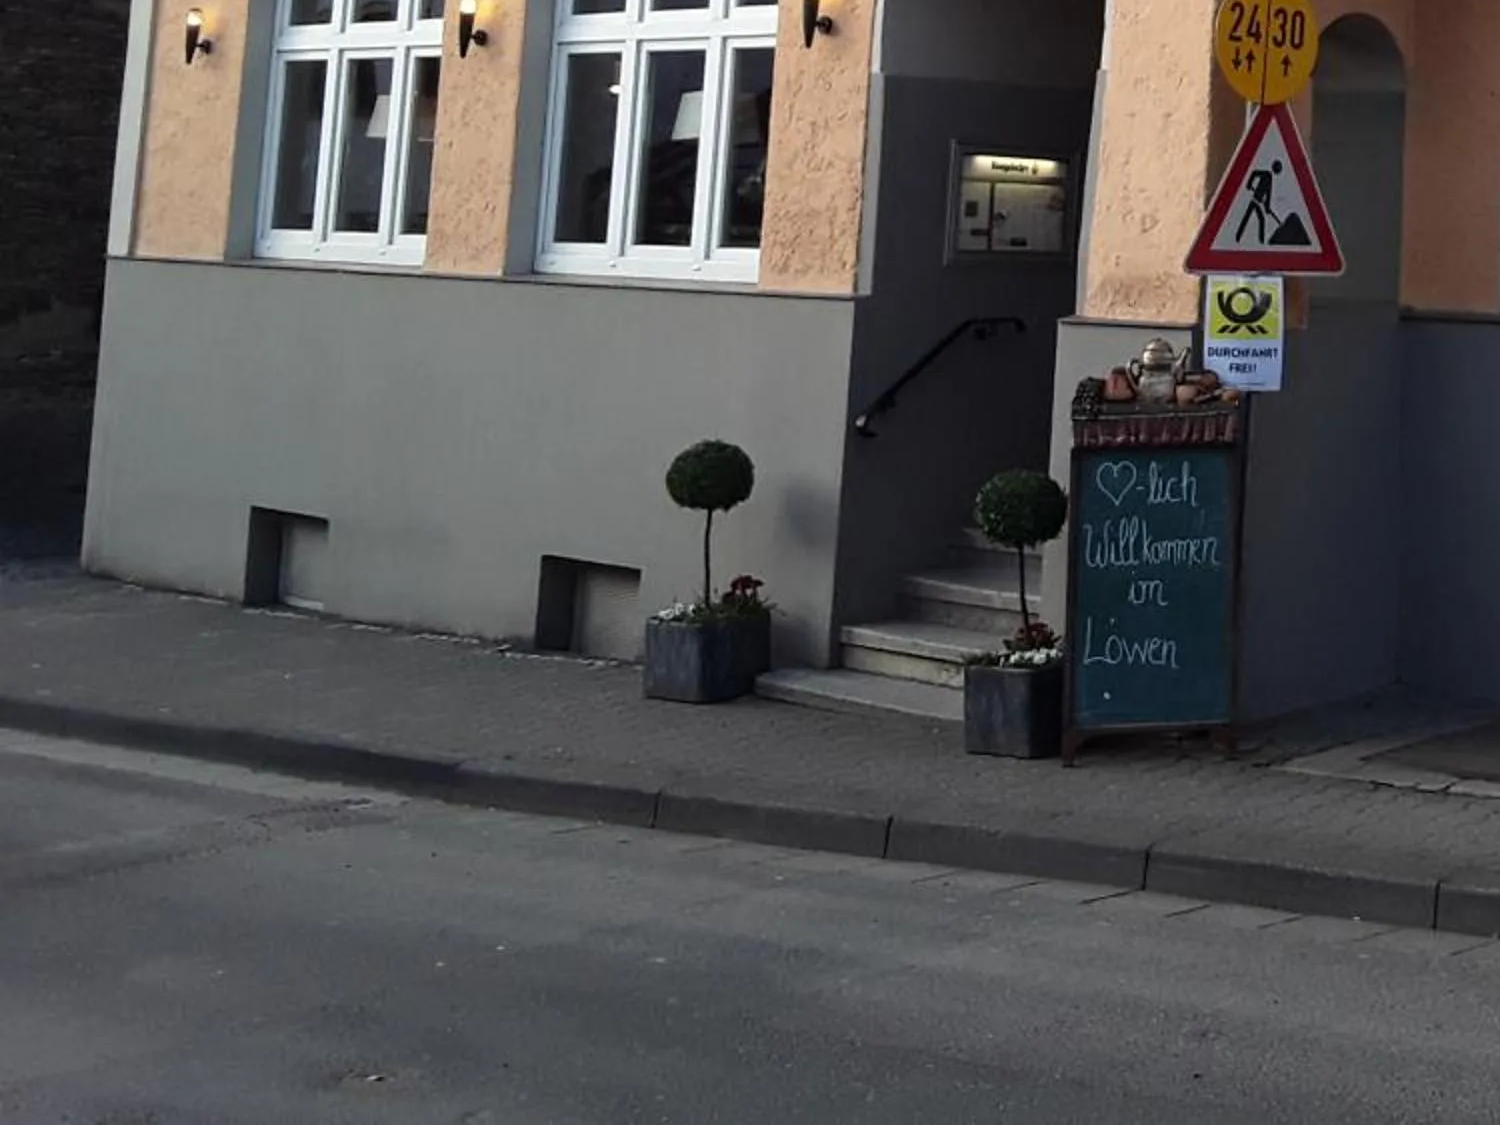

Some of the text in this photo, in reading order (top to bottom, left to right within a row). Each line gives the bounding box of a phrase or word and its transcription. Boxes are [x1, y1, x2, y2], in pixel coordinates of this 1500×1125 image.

[1228, 1, 1305, 50] 24 30
[1207, 346, 1278, 360] DURCHFAHRT
[1083, 517, 1220, 568] Willkommen
[1083, 616, 1180, 668] Löwen
